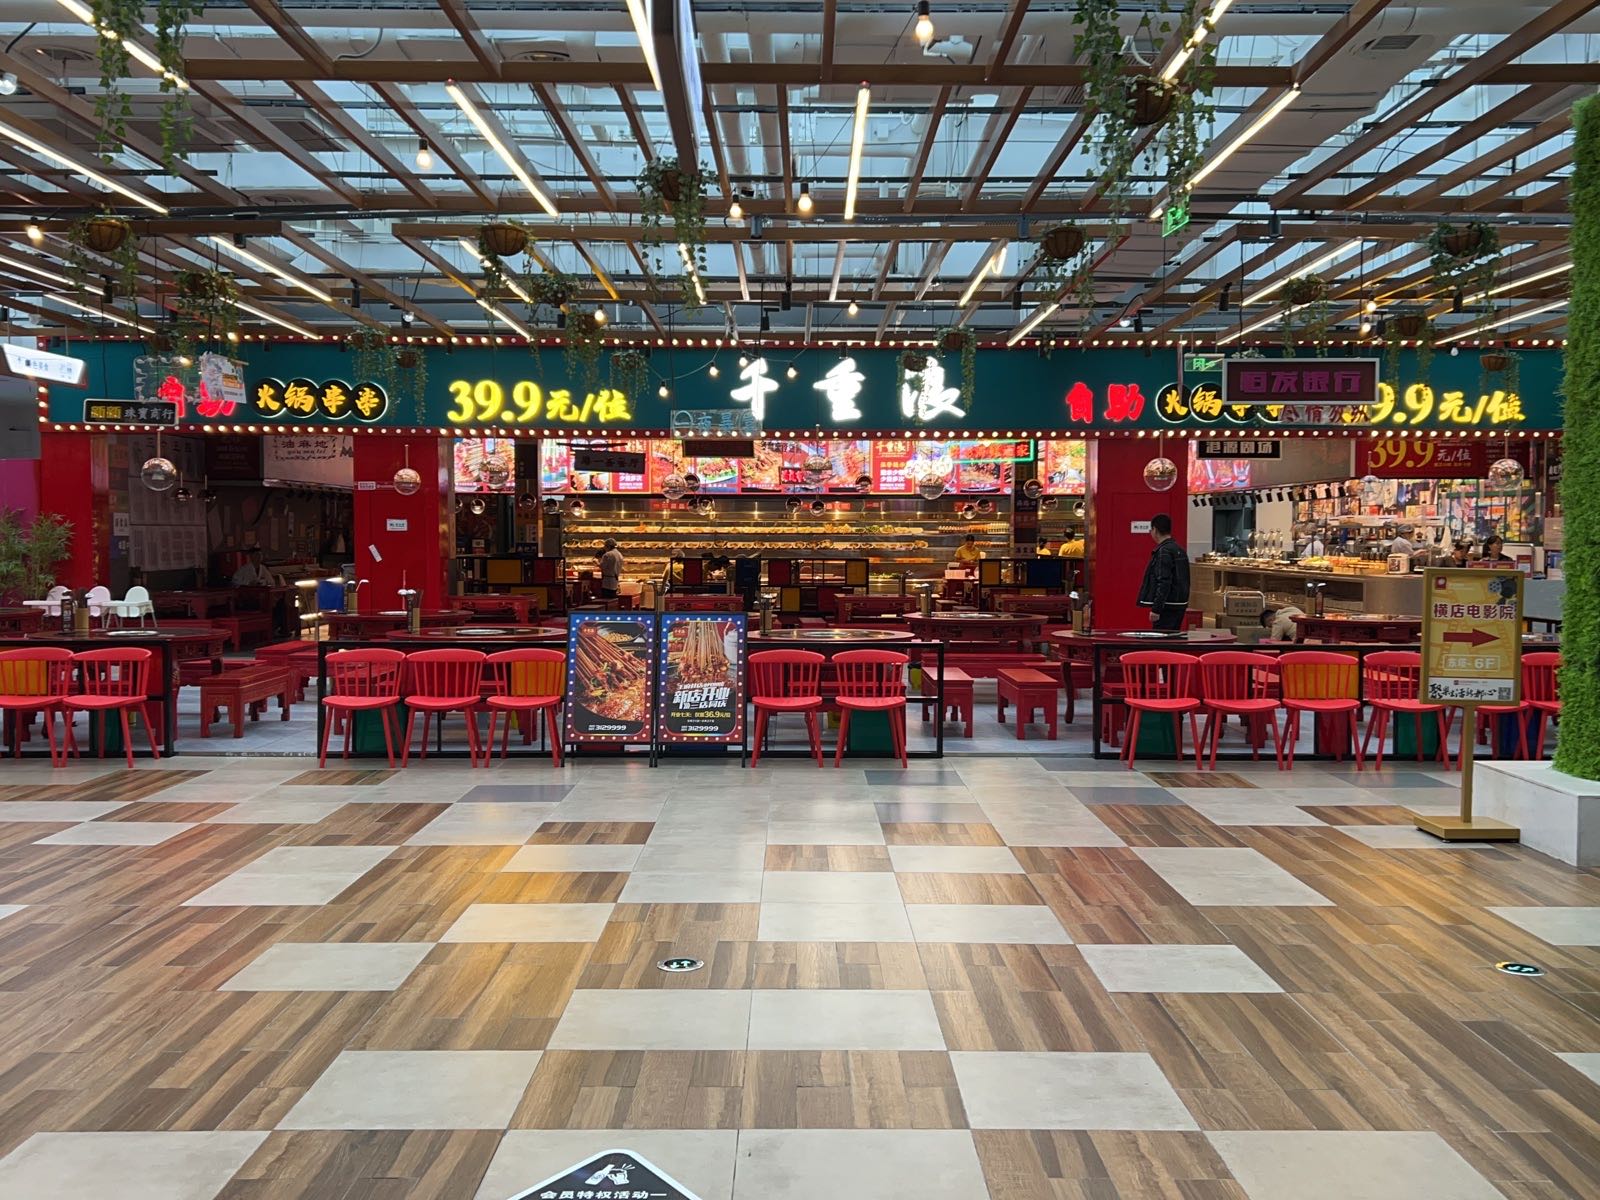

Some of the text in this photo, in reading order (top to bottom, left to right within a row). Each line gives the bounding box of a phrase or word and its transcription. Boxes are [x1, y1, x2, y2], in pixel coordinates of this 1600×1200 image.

[256, 383, 380, 416] 火锅串串
[447, 379, 632, 423] 39.9元/位
[730, 356, 966, 421] 千重浪
[1065, 382, 1145, 423] 自助
[1343, 381, 1527, 424] 9.9元/位
[1433, 603, 1515, 619] 横店电影院
[1474, 658, 1495, 669] 6F
